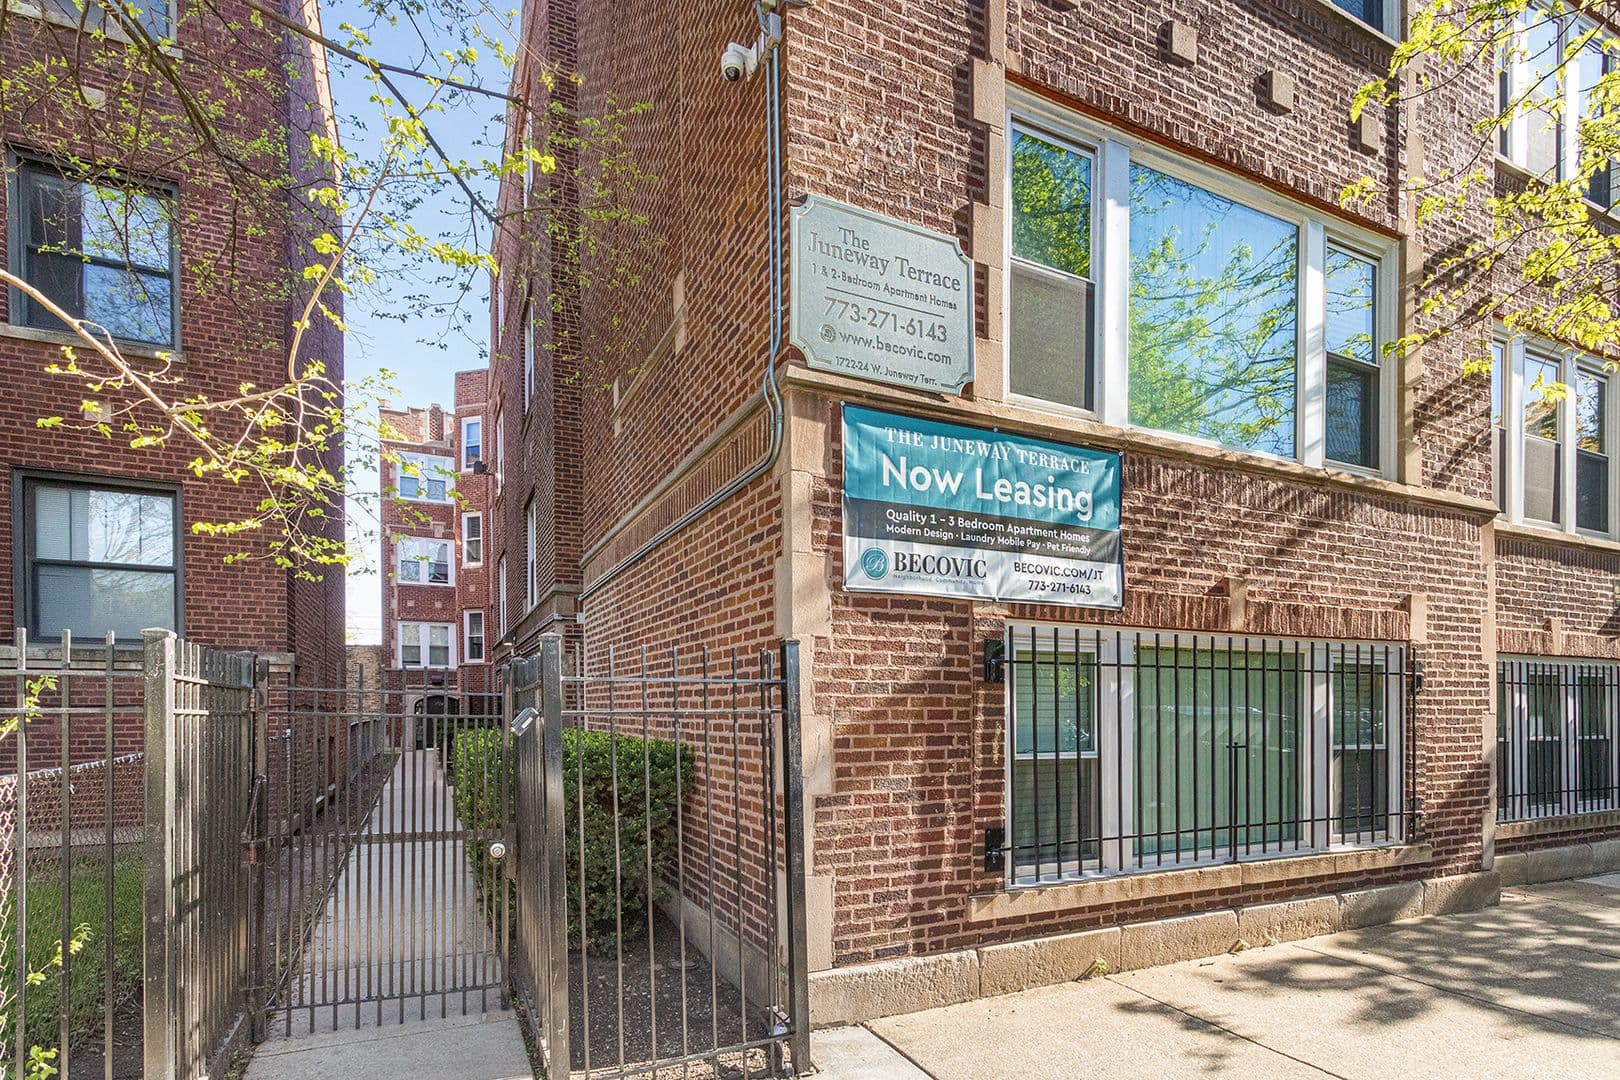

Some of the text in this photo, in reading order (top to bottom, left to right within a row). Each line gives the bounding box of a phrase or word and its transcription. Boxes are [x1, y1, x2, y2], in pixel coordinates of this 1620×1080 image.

[838, 226, 870, 251] The
[807, 231, 961, 292] Juneway Terrace
[812, 263, 958, 311] 1 & 2-Bedroom Apartment Homes
[824, 296, 948, 343] 773-271-6143
[839, 335, 952, 366] www.becovic.com
[835, 356, 938, 386] 1722-24 W. Juneway Terr.
[884, 427, 1090, 475] THE JUNEWAY TERRACE
[882, 453, 1093, 522] Now Leasing
[886, 509, 927, 525] Quality
[930, 514, 937, 524] 1
[948, 516, 955, 526] 3
[958, 517, 1005, 532] Bedroom
[1006, 523, 1058, 538] Apartment
[1060, 530, 1090, 543] Homes
[886, 524, 921, 535] Modern
[924, 528, 954, 540] Design
[961, 532, 995, 545] Laundry
[997, 537, 1024, 547] Mobile
[1026, 540, 1041, 550] Pay
[1047, 542, 1060, 551] Pet
[1061, 544, 1091, 556] Friendly
[893, 551, 987, 579] BECOVIC
[1014, 561, 1104, 581] BECOVIC.COM/JT
[1028, 580, 1091, 595] 773-271-6143
